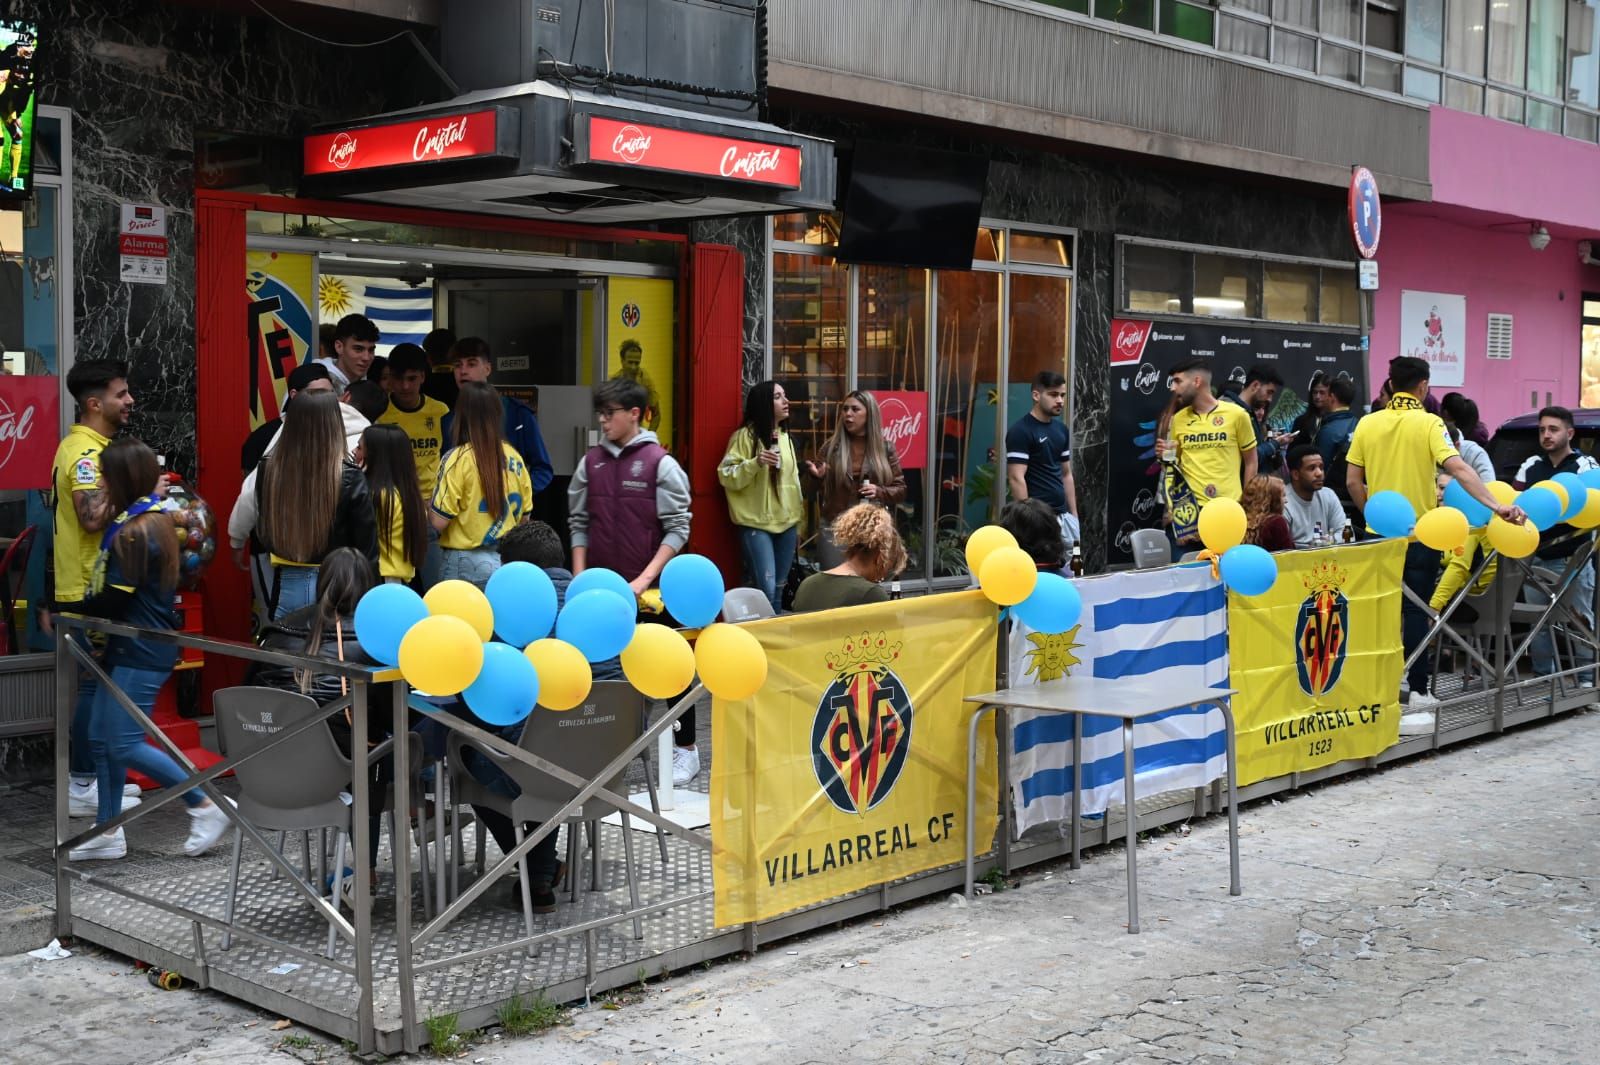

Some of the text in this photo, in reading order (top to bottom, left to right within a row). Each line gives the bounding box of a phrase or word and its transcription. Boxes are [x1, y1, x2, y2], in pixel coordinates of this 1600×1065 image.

[412, 116, 468, 161] Cristal
[612, 134, 652, 154] Cristal
[328, 138, 357, 163] Cristal
[720, 146, 780, 177] Cristal
[1363, 200, 1371, 227] P
[123, 237, 165, 250] Alarma
[1116, 325, 1144, 348] Cristal
[1134, 370, 1161, 388] Cristal
[1183, 432, 1227, 444] PAMESA
[558, 718, 586, 728] CERVEZAS
[1265, 703, 1382, 746] VILLARREAL CF
[1308, 737, 1333, 757] 1923
[765, 812, 955, 887] VILLARREAL CF
